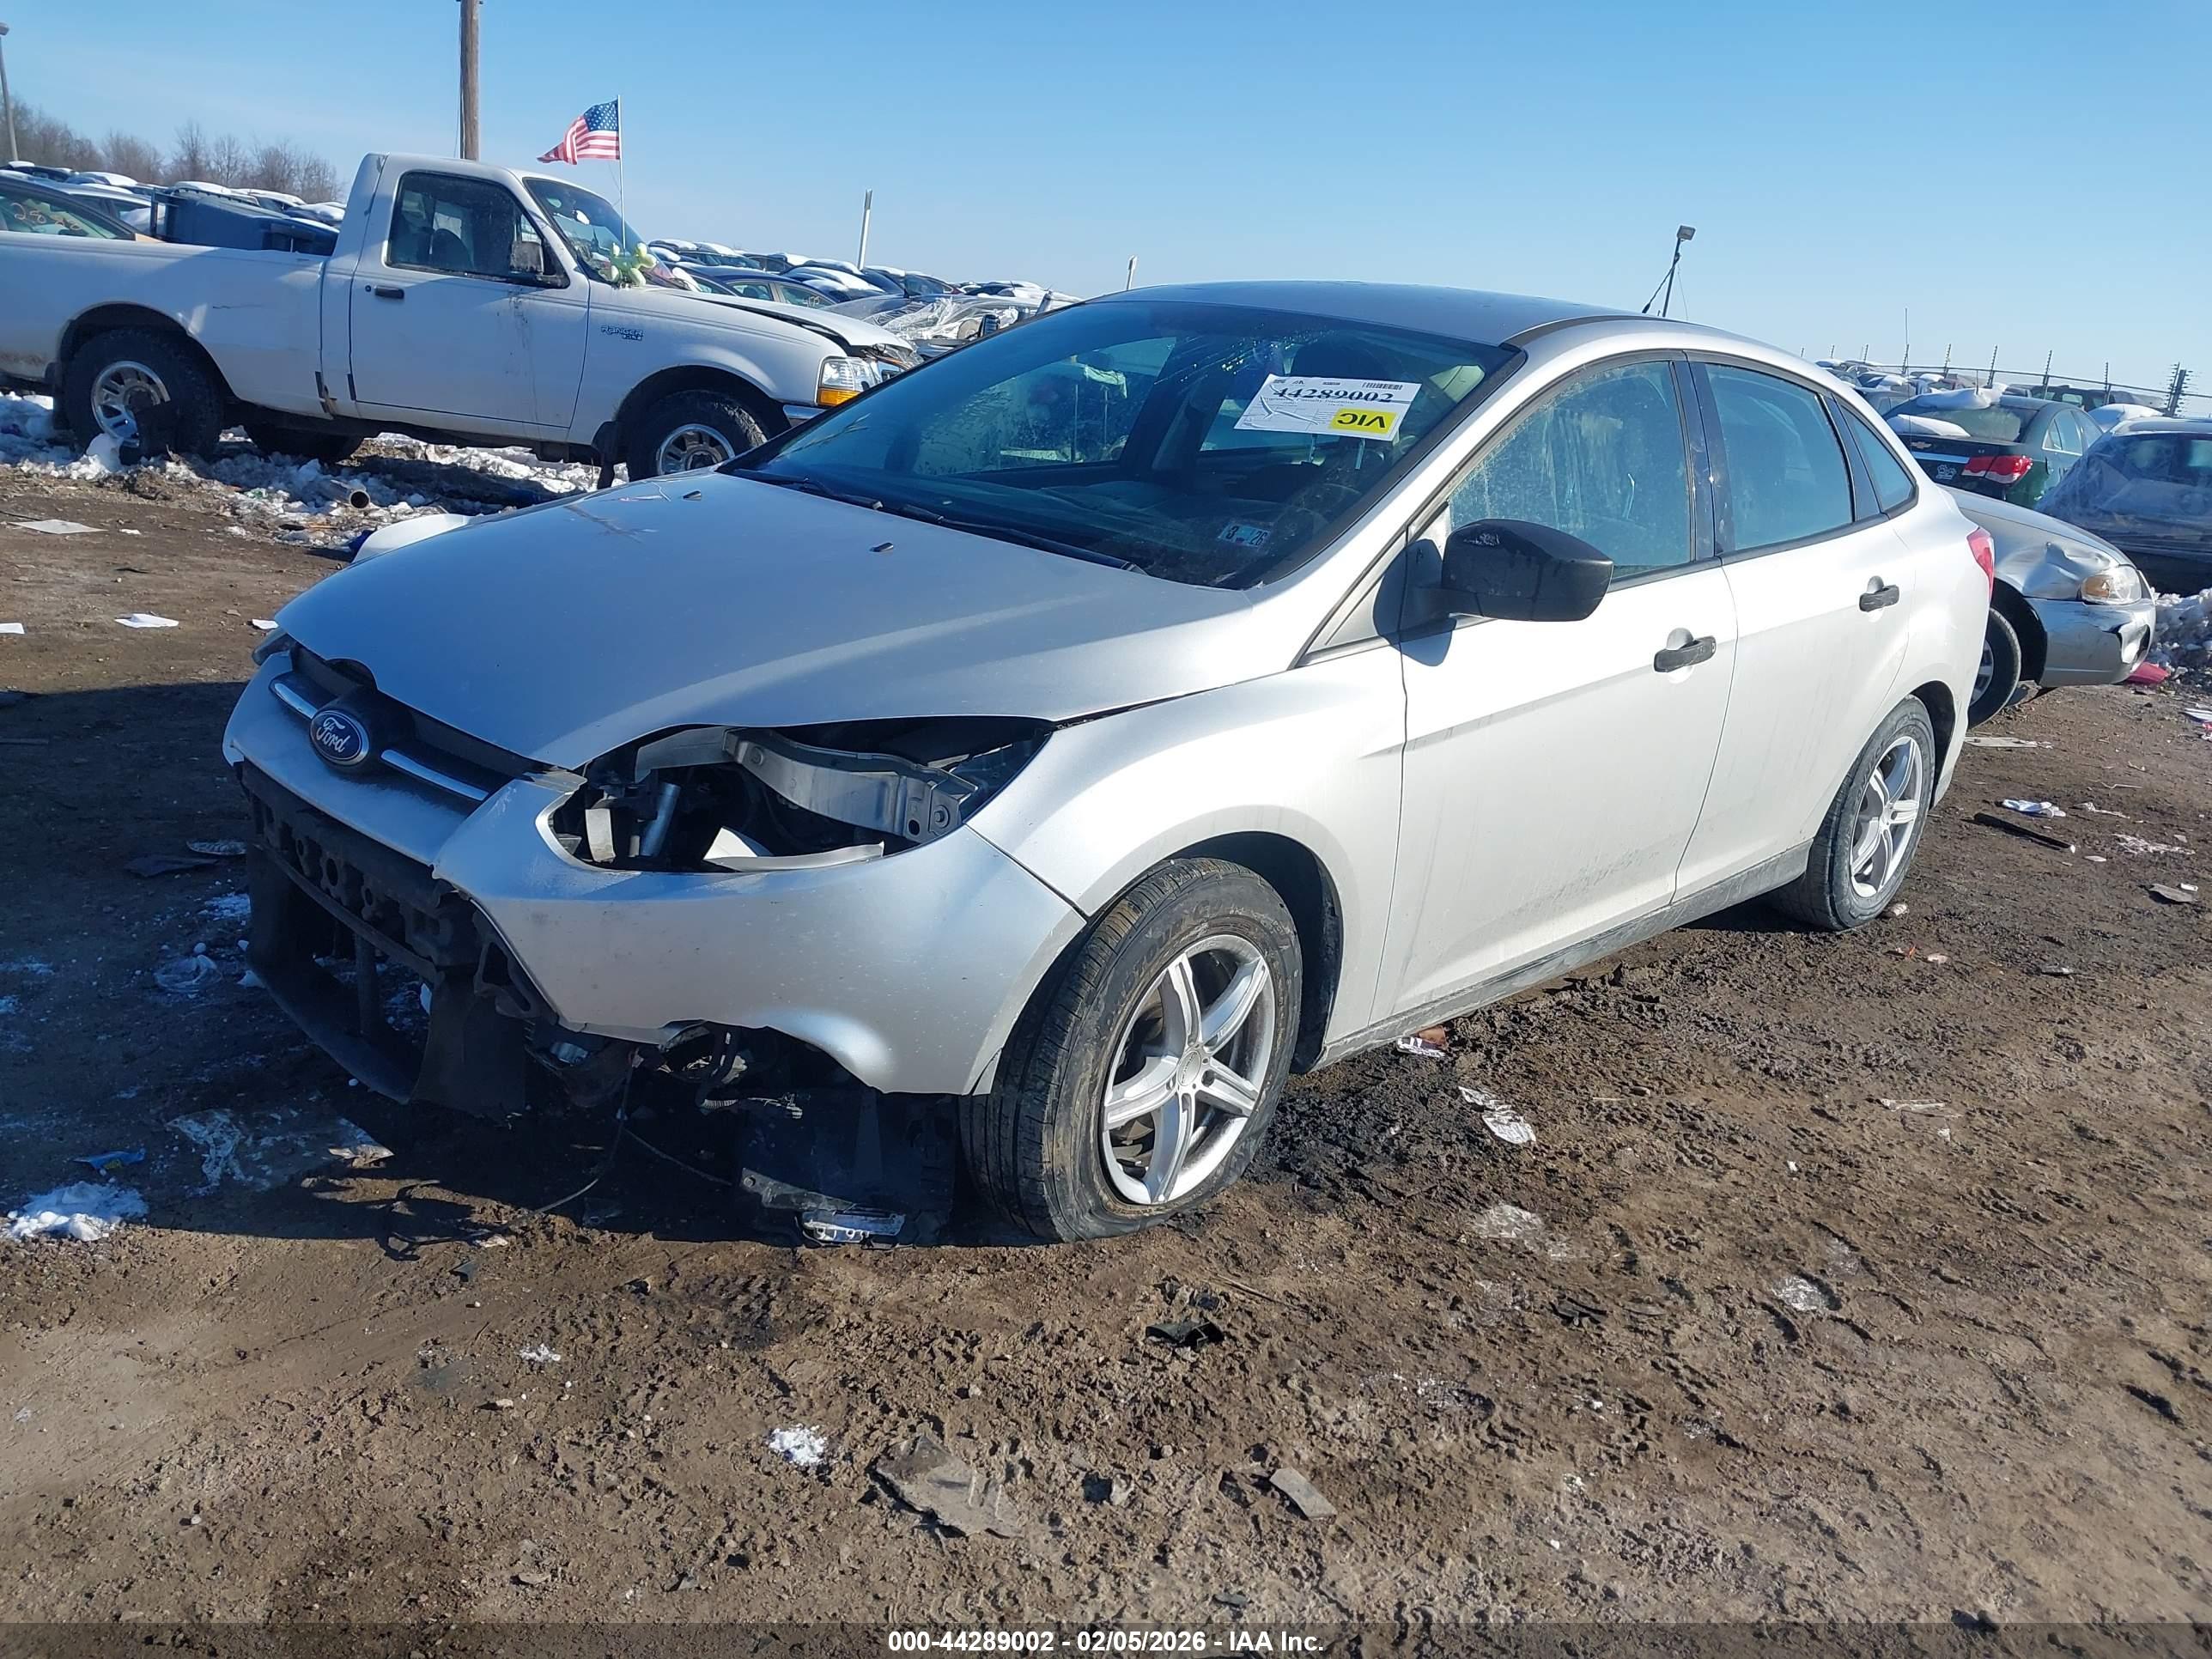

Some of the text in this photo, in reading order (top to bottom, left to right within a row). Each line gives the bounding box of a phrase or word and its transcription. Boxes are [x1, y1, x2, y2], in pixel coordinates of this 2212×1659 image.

[600, 325, 644, 337] RANGER
[1273, 386, 1395, 403] 44289002
[1337, 412, 1386, 428] VIC
[1225, 526, 1239, 539] 3
[316, 717, 350, 753] Ford
